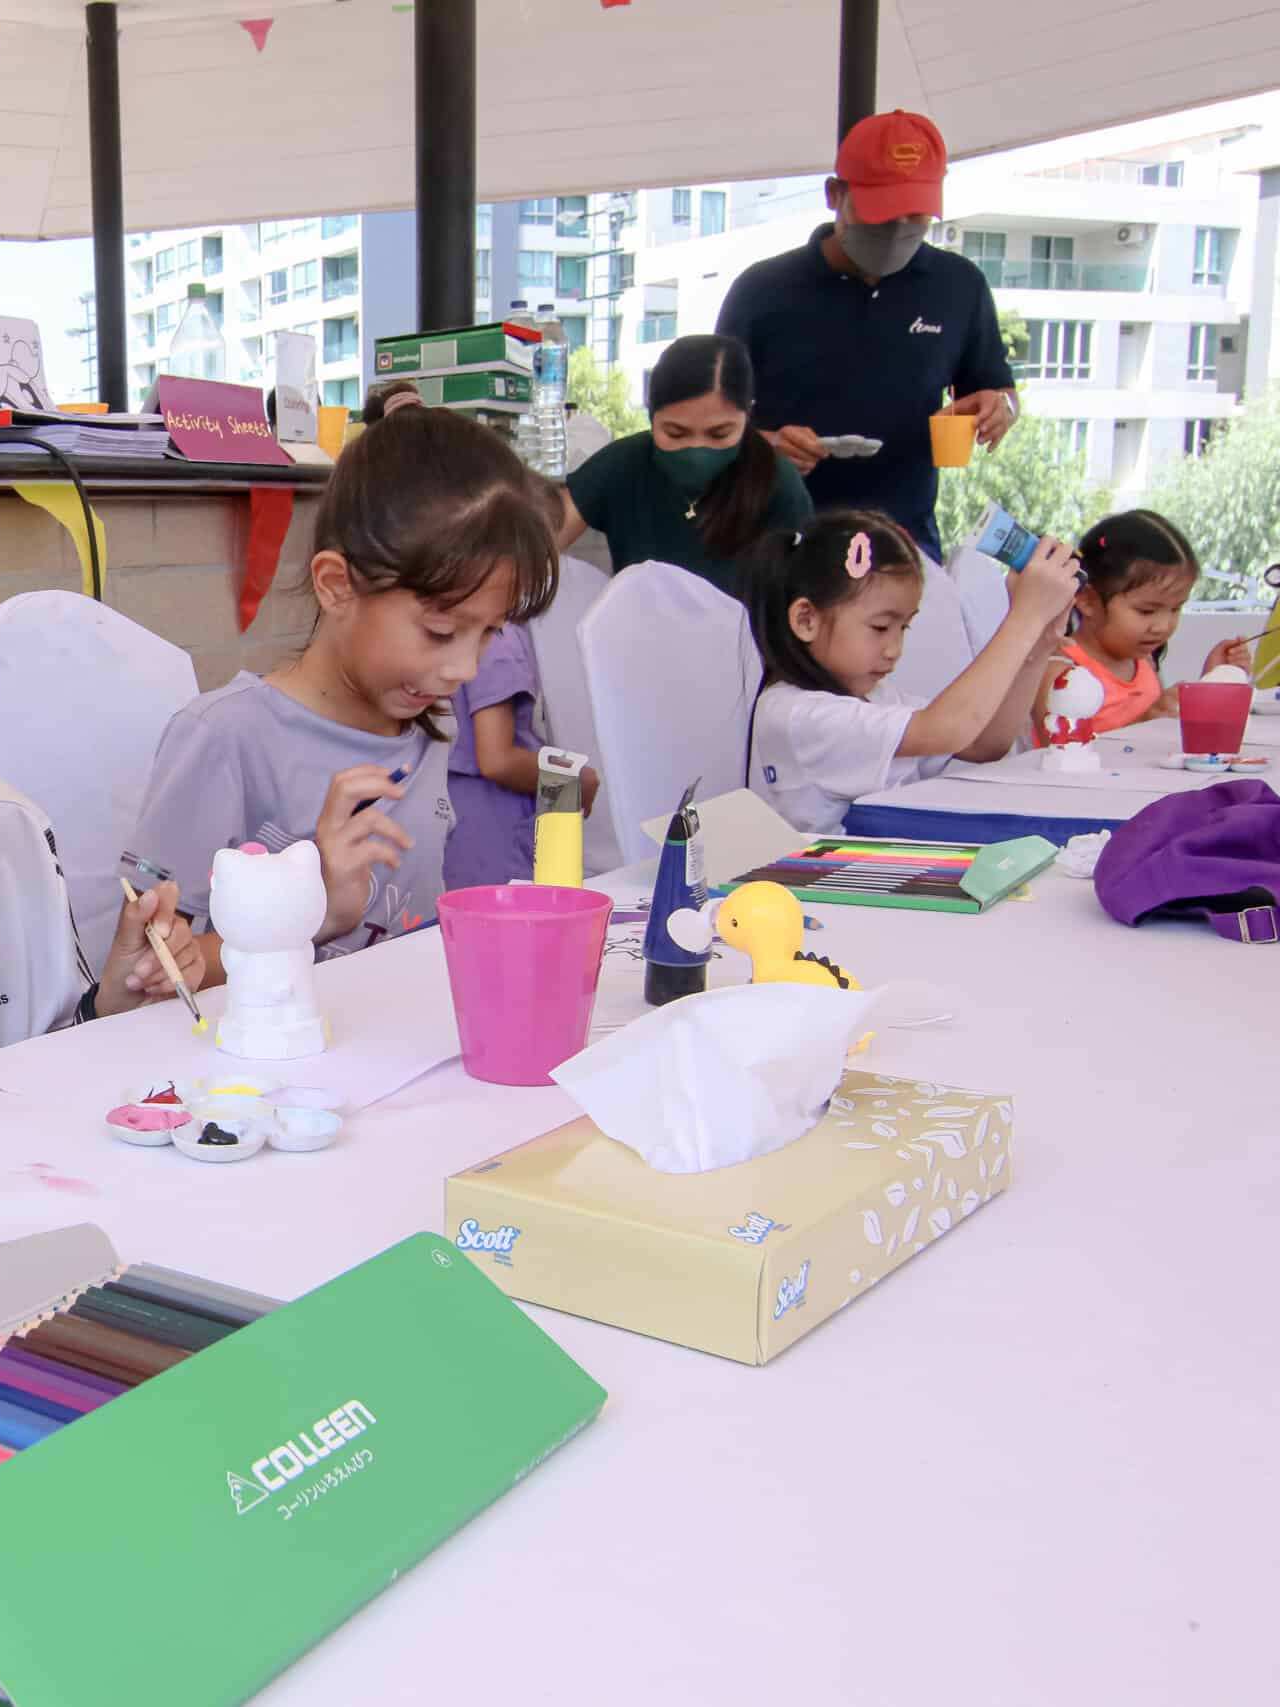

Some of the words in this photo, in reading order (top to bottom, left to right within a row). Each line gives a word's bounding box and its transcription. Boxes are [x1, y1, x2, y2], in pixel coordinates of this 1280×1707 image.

[167, 409, 223, 439] Activity
[456, 1217, 517, 1252] Scott
[727, 1211, 775, 1245] Scott
[252, 1399, 377, 1492] COLLEEN
